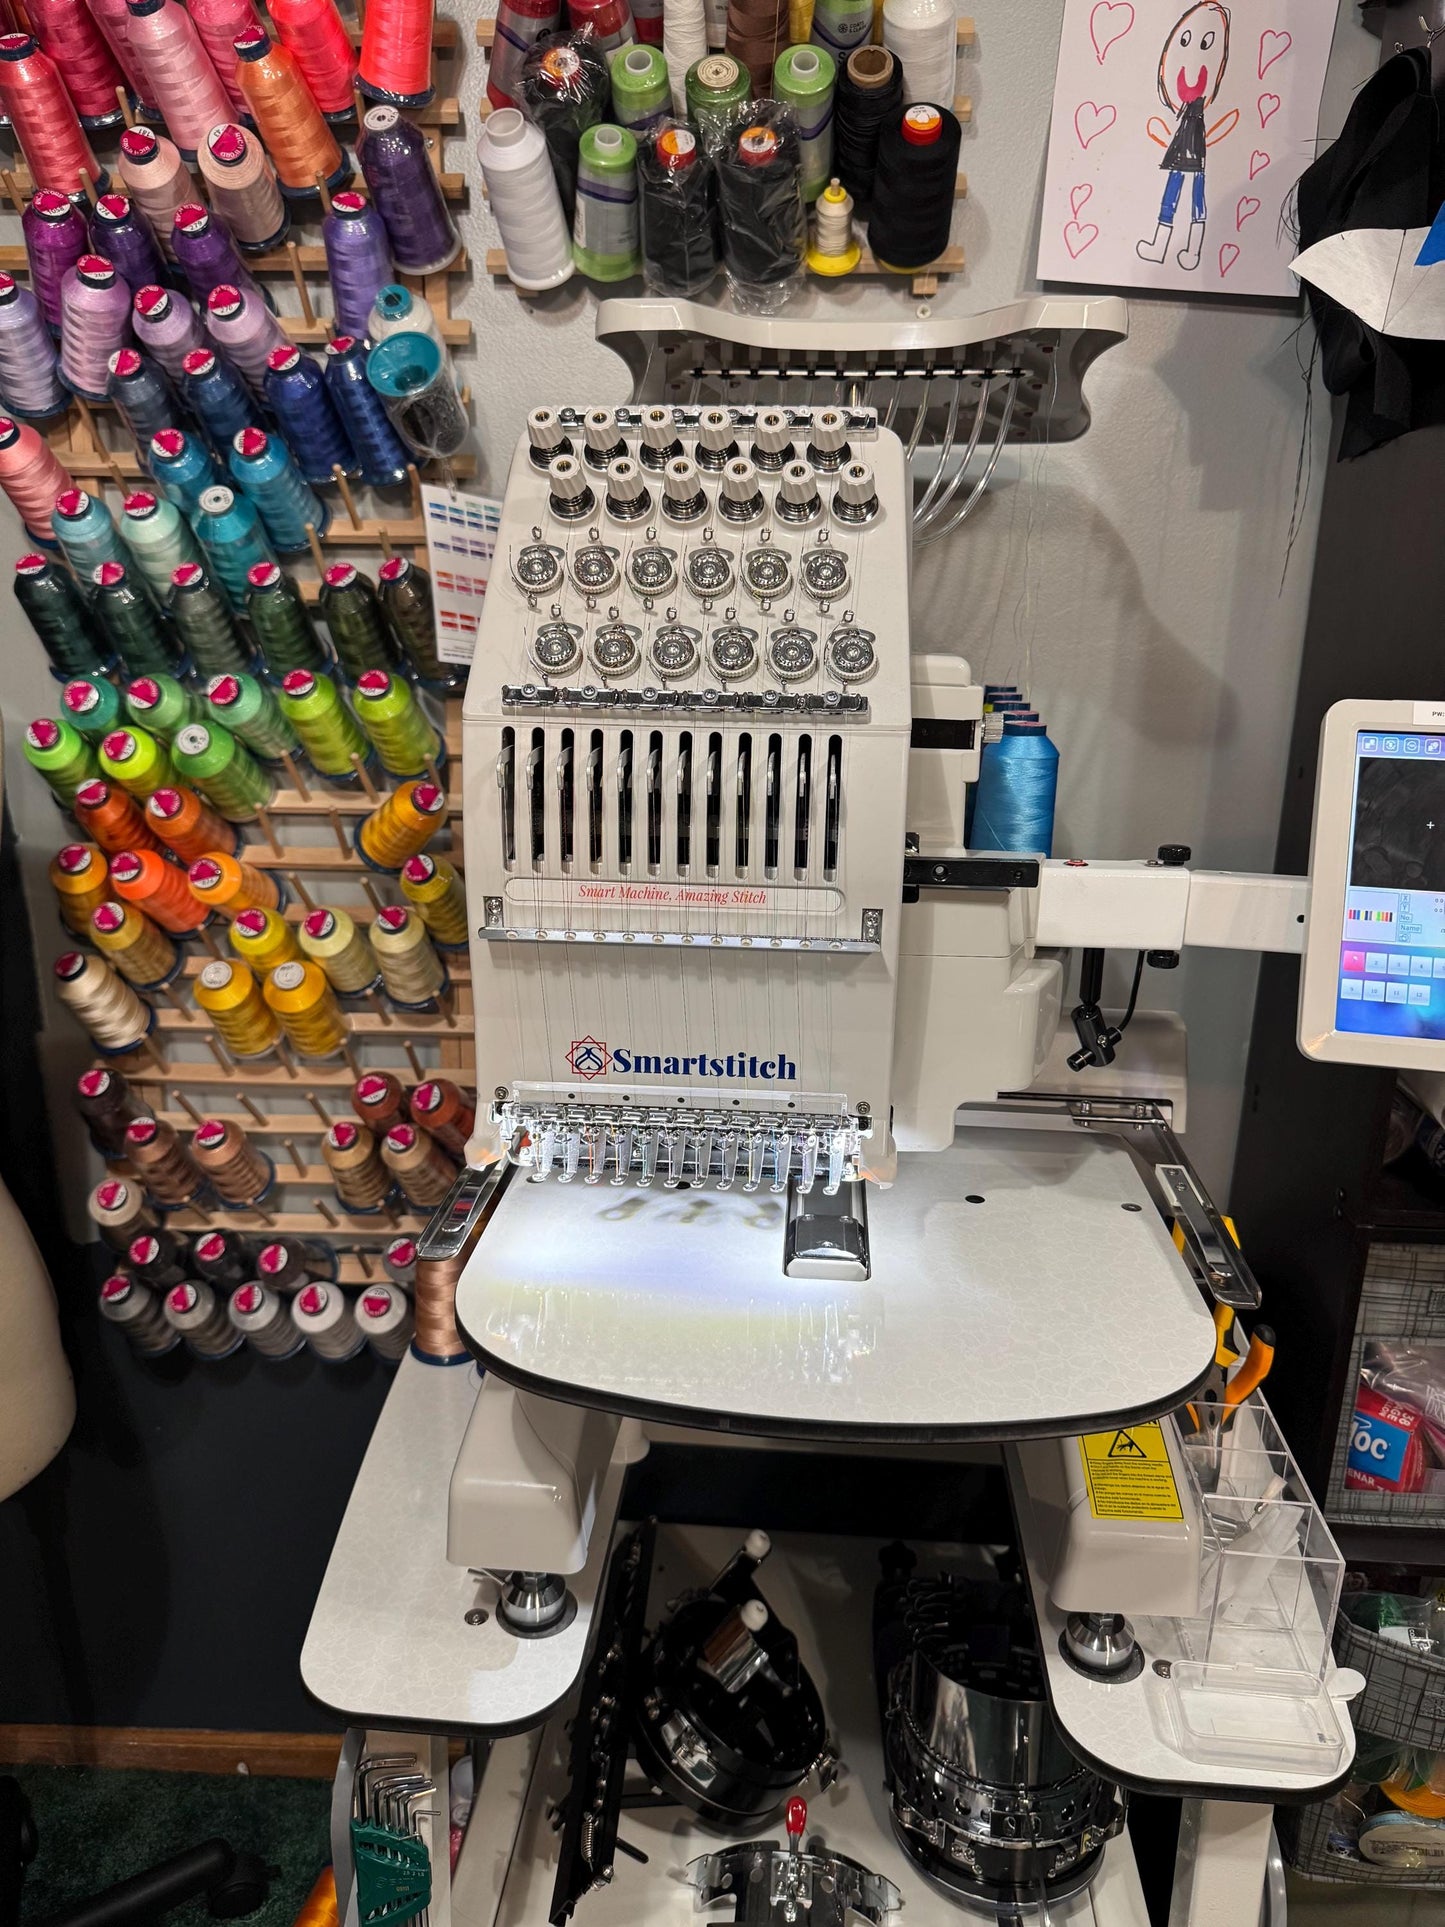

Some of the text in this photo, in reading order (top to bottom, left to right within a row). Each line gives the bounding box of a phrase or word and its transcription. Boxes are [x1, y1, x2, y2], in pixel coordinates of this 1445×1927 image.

[578, 885, 767, 905] Smart Machine, Amazing Stitch
[612, 1048, 797, 1080] Smartstitch
